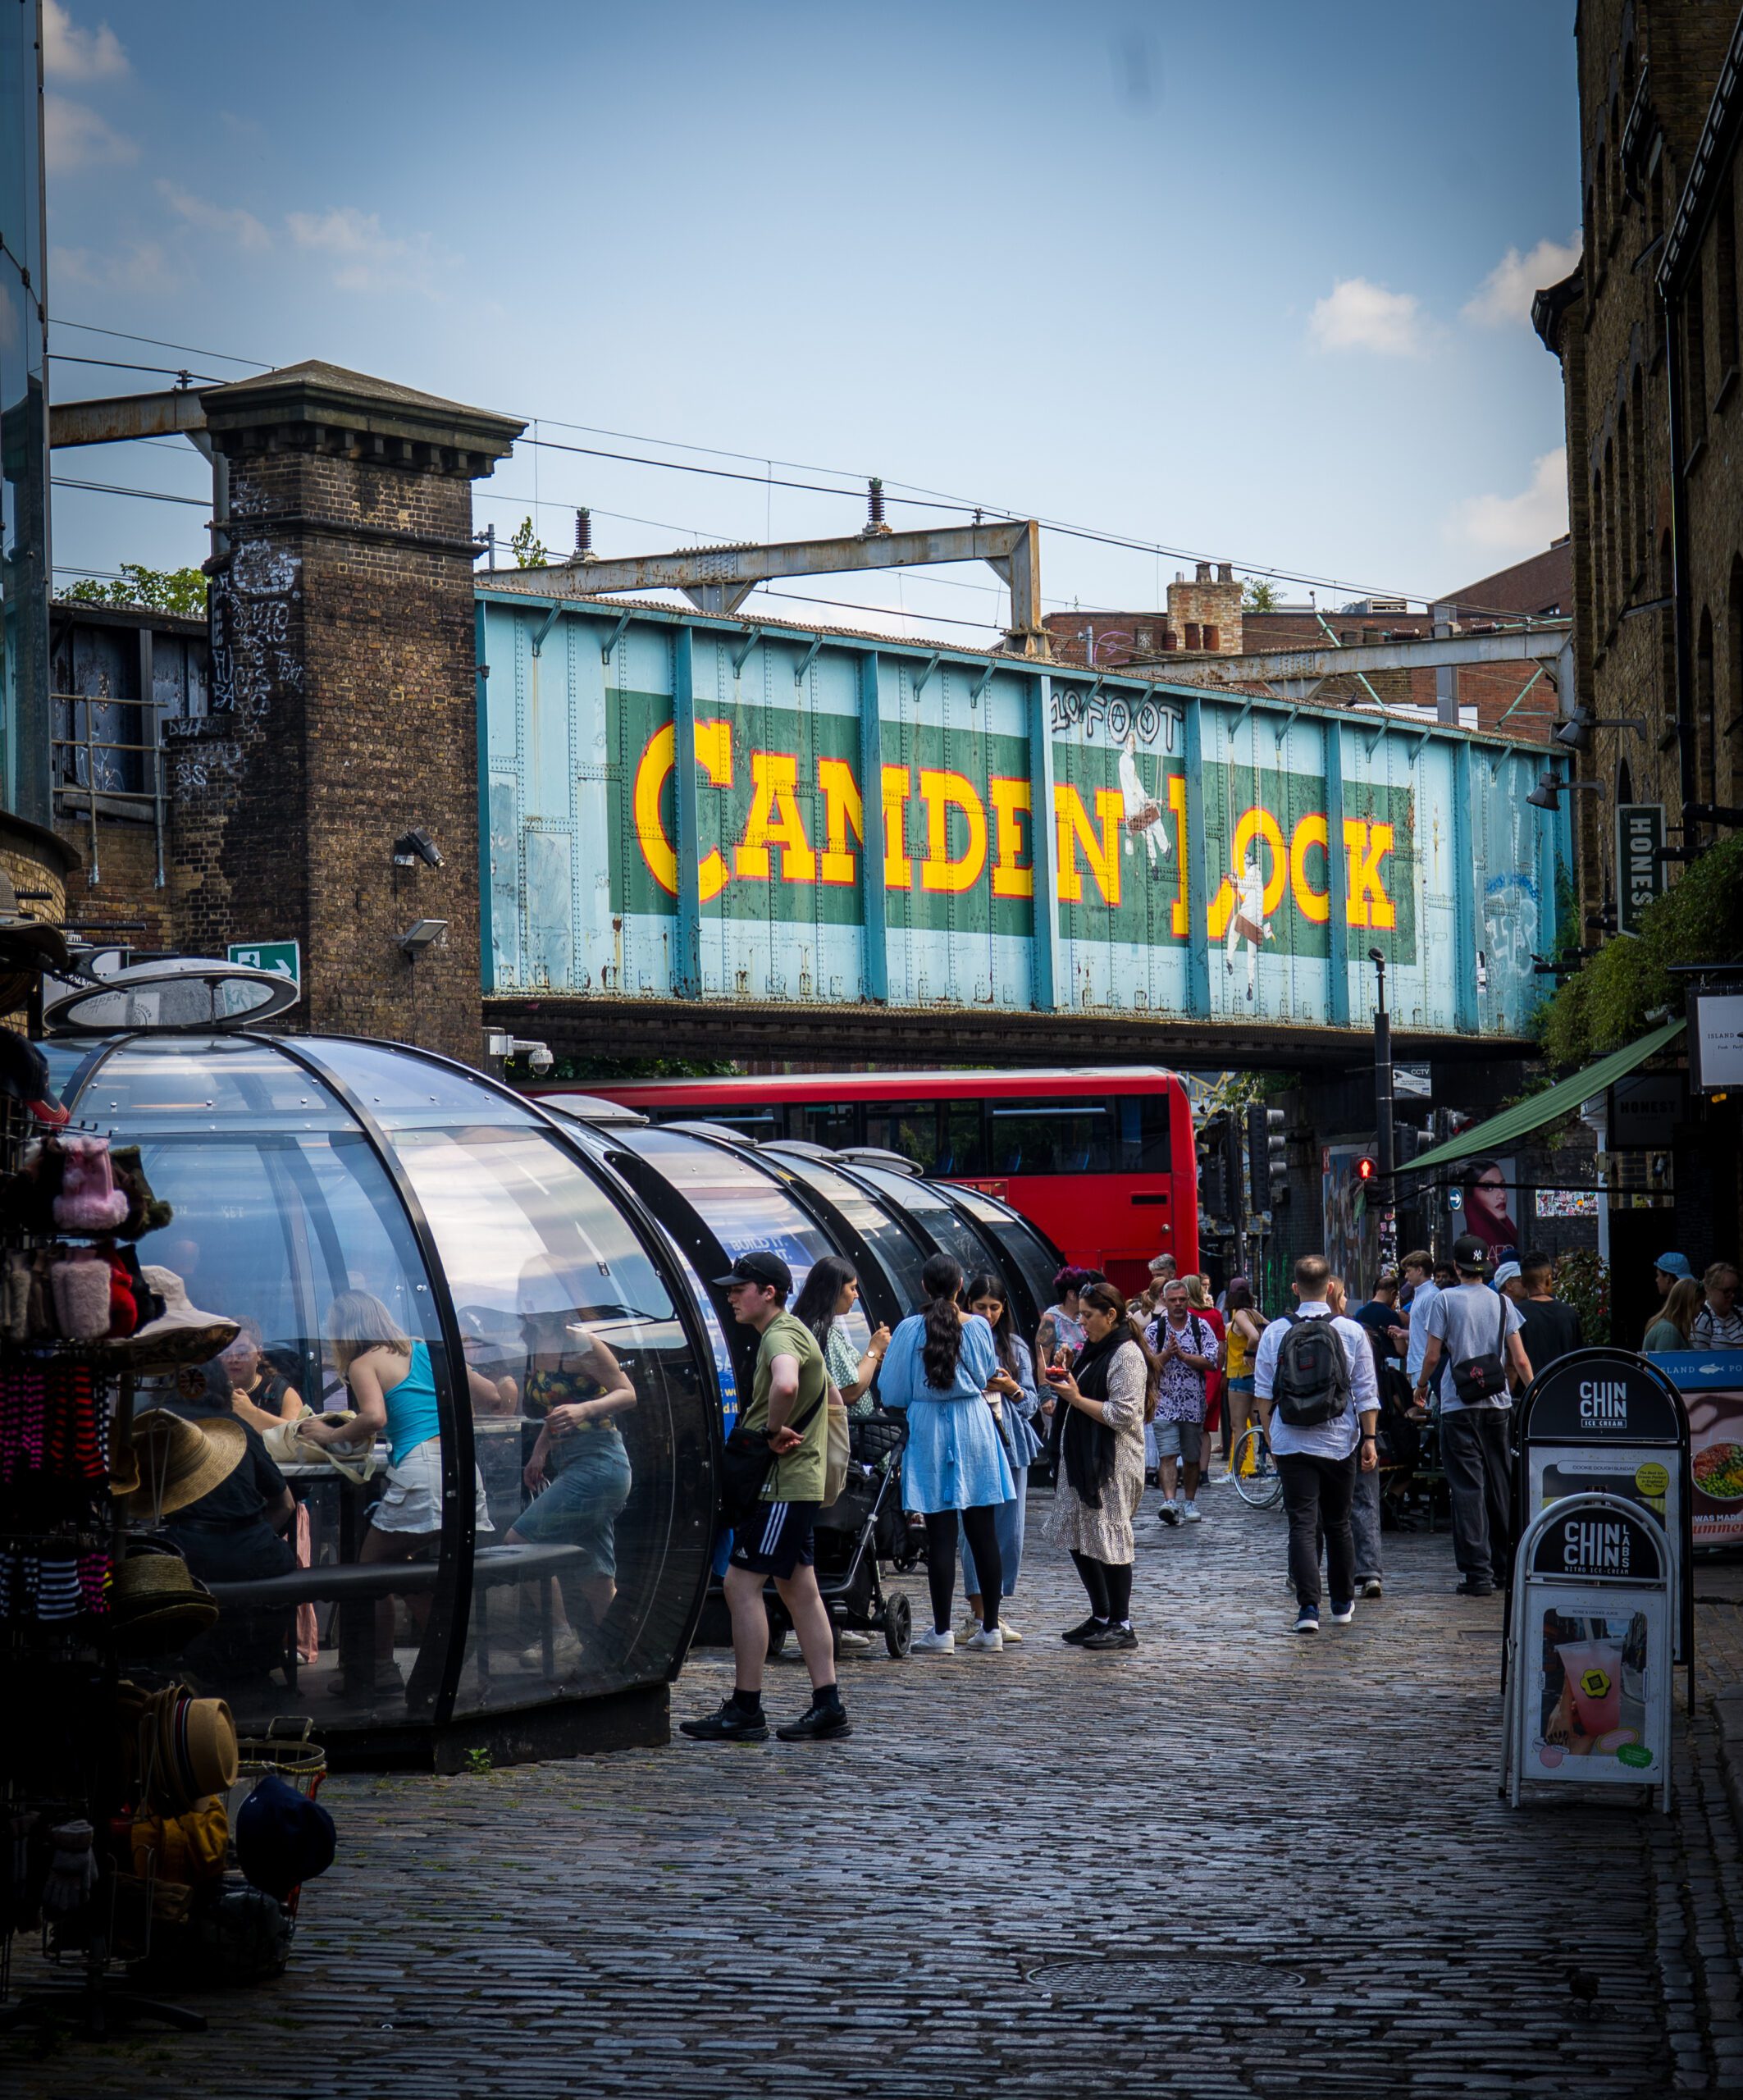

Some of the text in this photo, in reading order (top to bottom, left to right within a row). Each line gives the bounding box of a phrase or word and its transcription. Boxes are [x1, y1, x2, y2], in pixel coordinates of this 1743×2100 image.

[633, 718, 1398, 943] CAMDEN LOCK
[1621, 1100, 1677, 1114] HONEST
[729, 1237, 770, 1252] BUILD
[1661, 1365, 1695, 1375] SLAND
[1579, 1381, 1627, 1400] CHIN
[1580, 1399, 1627, 1418] CHIN
[1695, 1513, 1743, 1522] WAS MADE
[1564, 1521, 1620, 1544] CHIN
[1621, 1523, 1631, 1568] LABS
[1563, 1544, 1620, 1567] CHIN
[1590, 1567, 1630, 1575] ICE-CREAM
